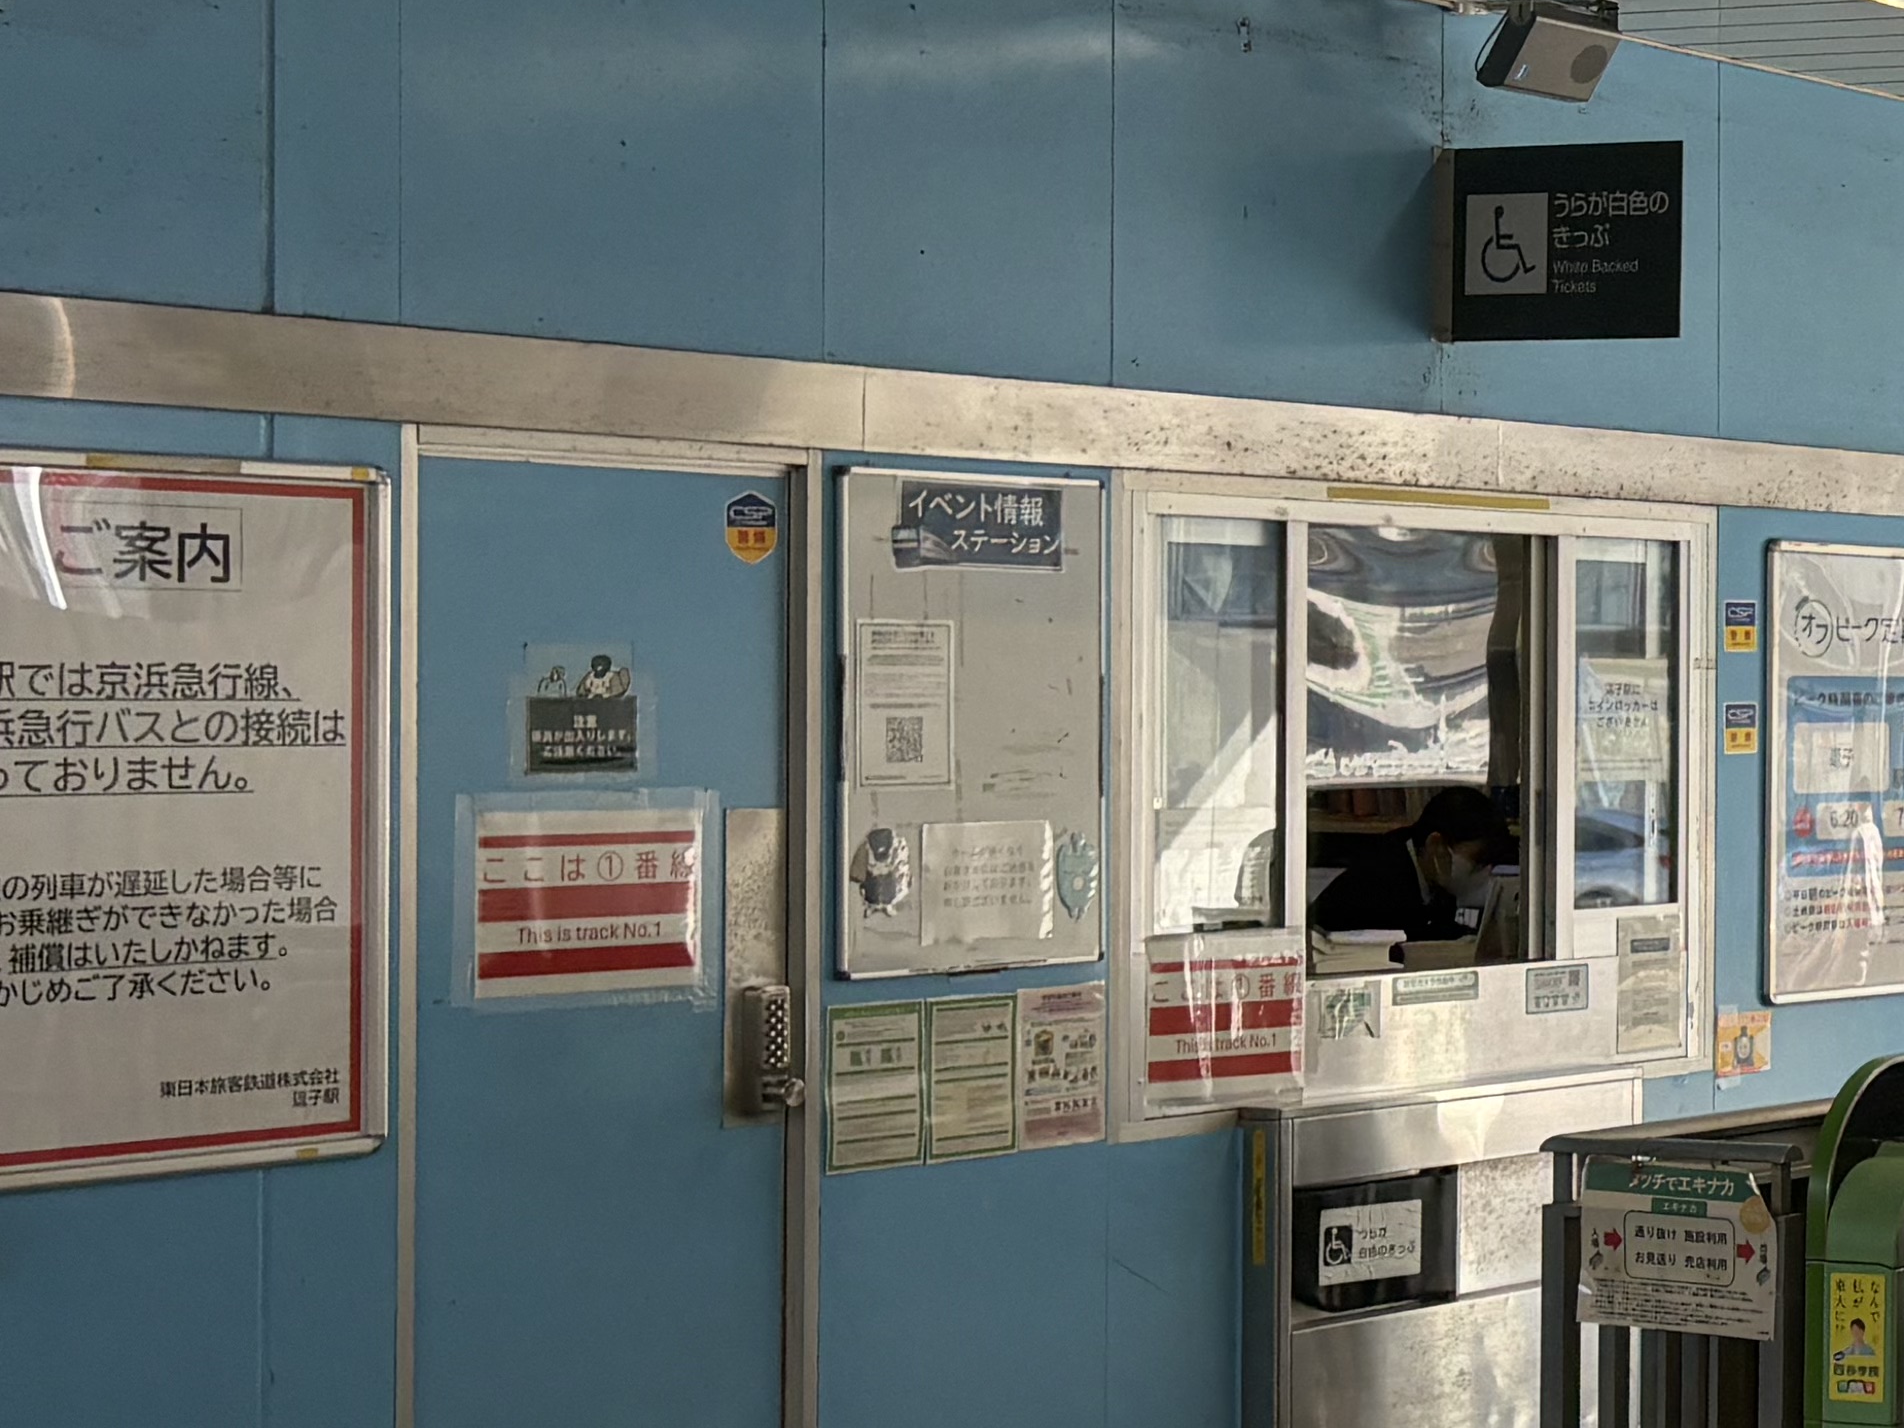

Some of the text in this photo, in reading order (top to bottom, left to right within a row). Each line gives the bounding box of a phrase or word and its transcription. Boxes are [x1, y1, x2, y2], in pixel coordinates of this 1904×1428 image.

[1554, 190, 1670, 218] うらが白色の
[1552, 222, 1611, 249] きっぷ
[1591, 257, 1639, 274] Backed
[1552, 278, 1597, 295] Tickets
[908, 489, 1044, 527] イベント情報
[55, 518, 232, 584] ご案内
[951, 528, 1061, 555] ステーション
[517, 921, 662, 945] This is track No.1
[1249, 1032, 1277, 1048] No.1
[160, 1067, 341, 1099] 東日本旅客鉄道株式会社
